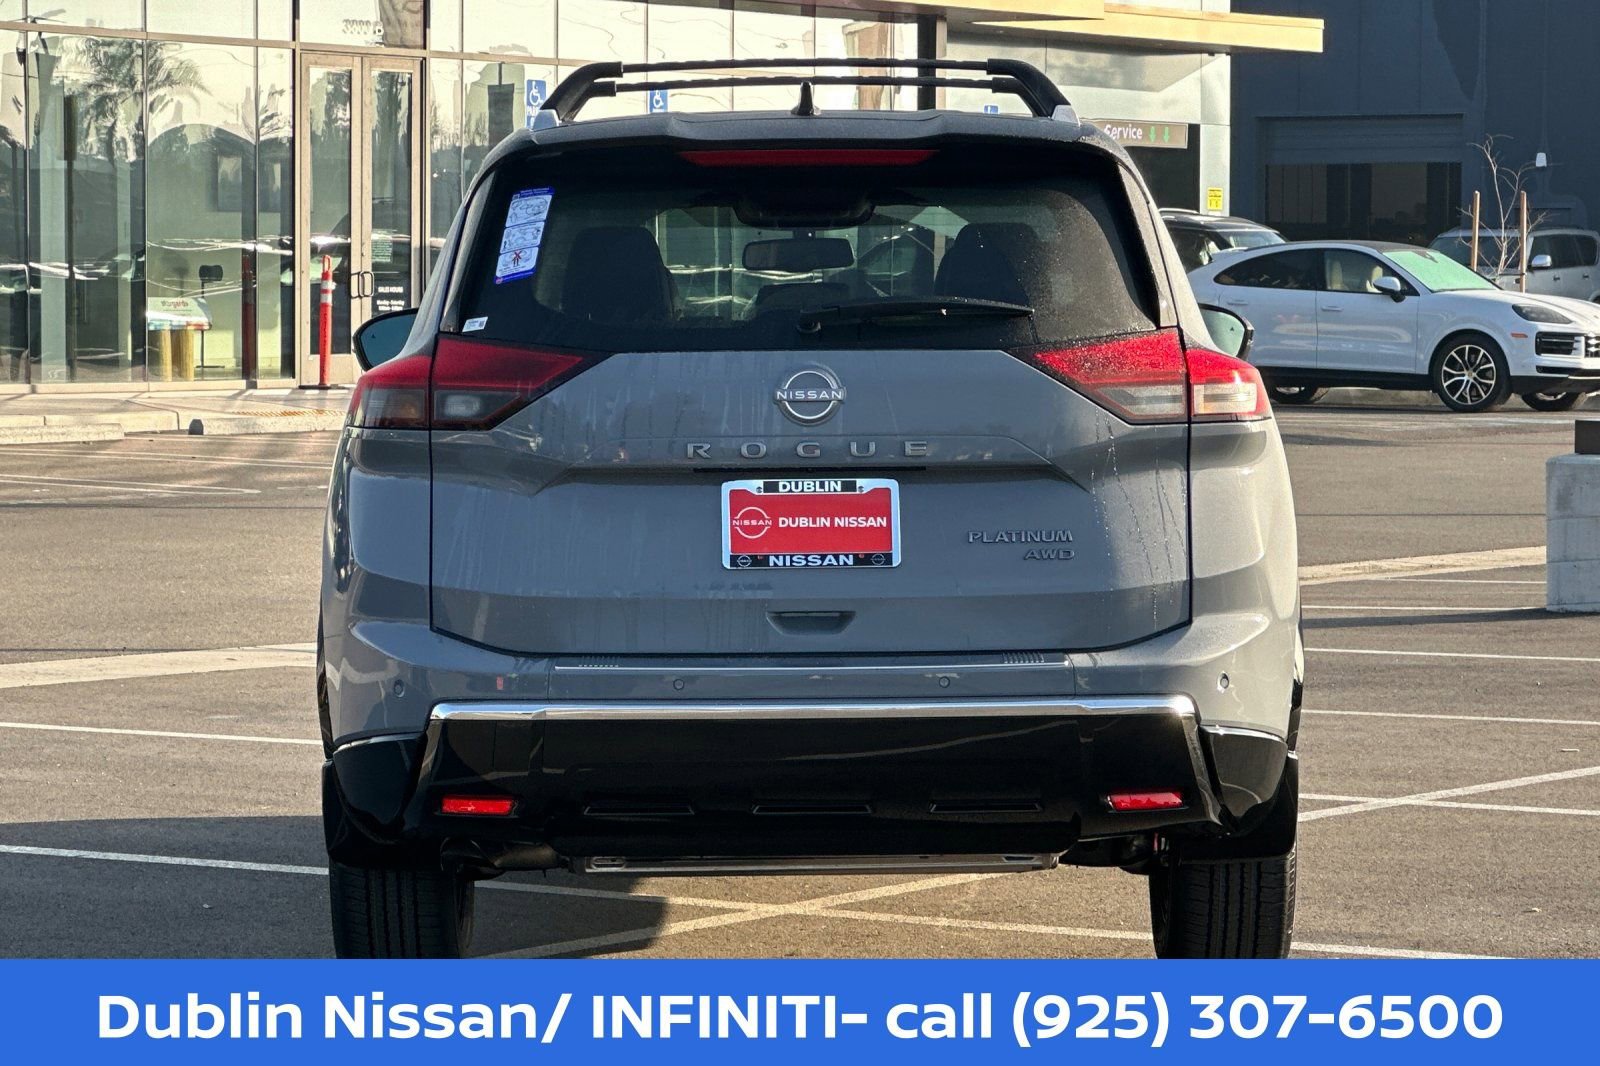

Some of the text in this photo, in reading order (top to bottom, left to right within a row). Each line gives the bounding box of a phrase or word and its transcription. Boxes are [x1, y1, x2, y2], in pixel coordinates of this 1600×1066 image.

[1104, 124, 1143, 139] Service
[776, 390, 842, 400] NISSAN
[687, 440, 927, 459] ROGUE
[778, 480, 842, 492] DUBLIN
[778, 516, 887, 528] DUBLIN NISSAN
[968, 530, 1073, 543] PLATINUM
[1024, 548, 1075, 560] AWD
[769, 555, 854, 567] NISSAN
